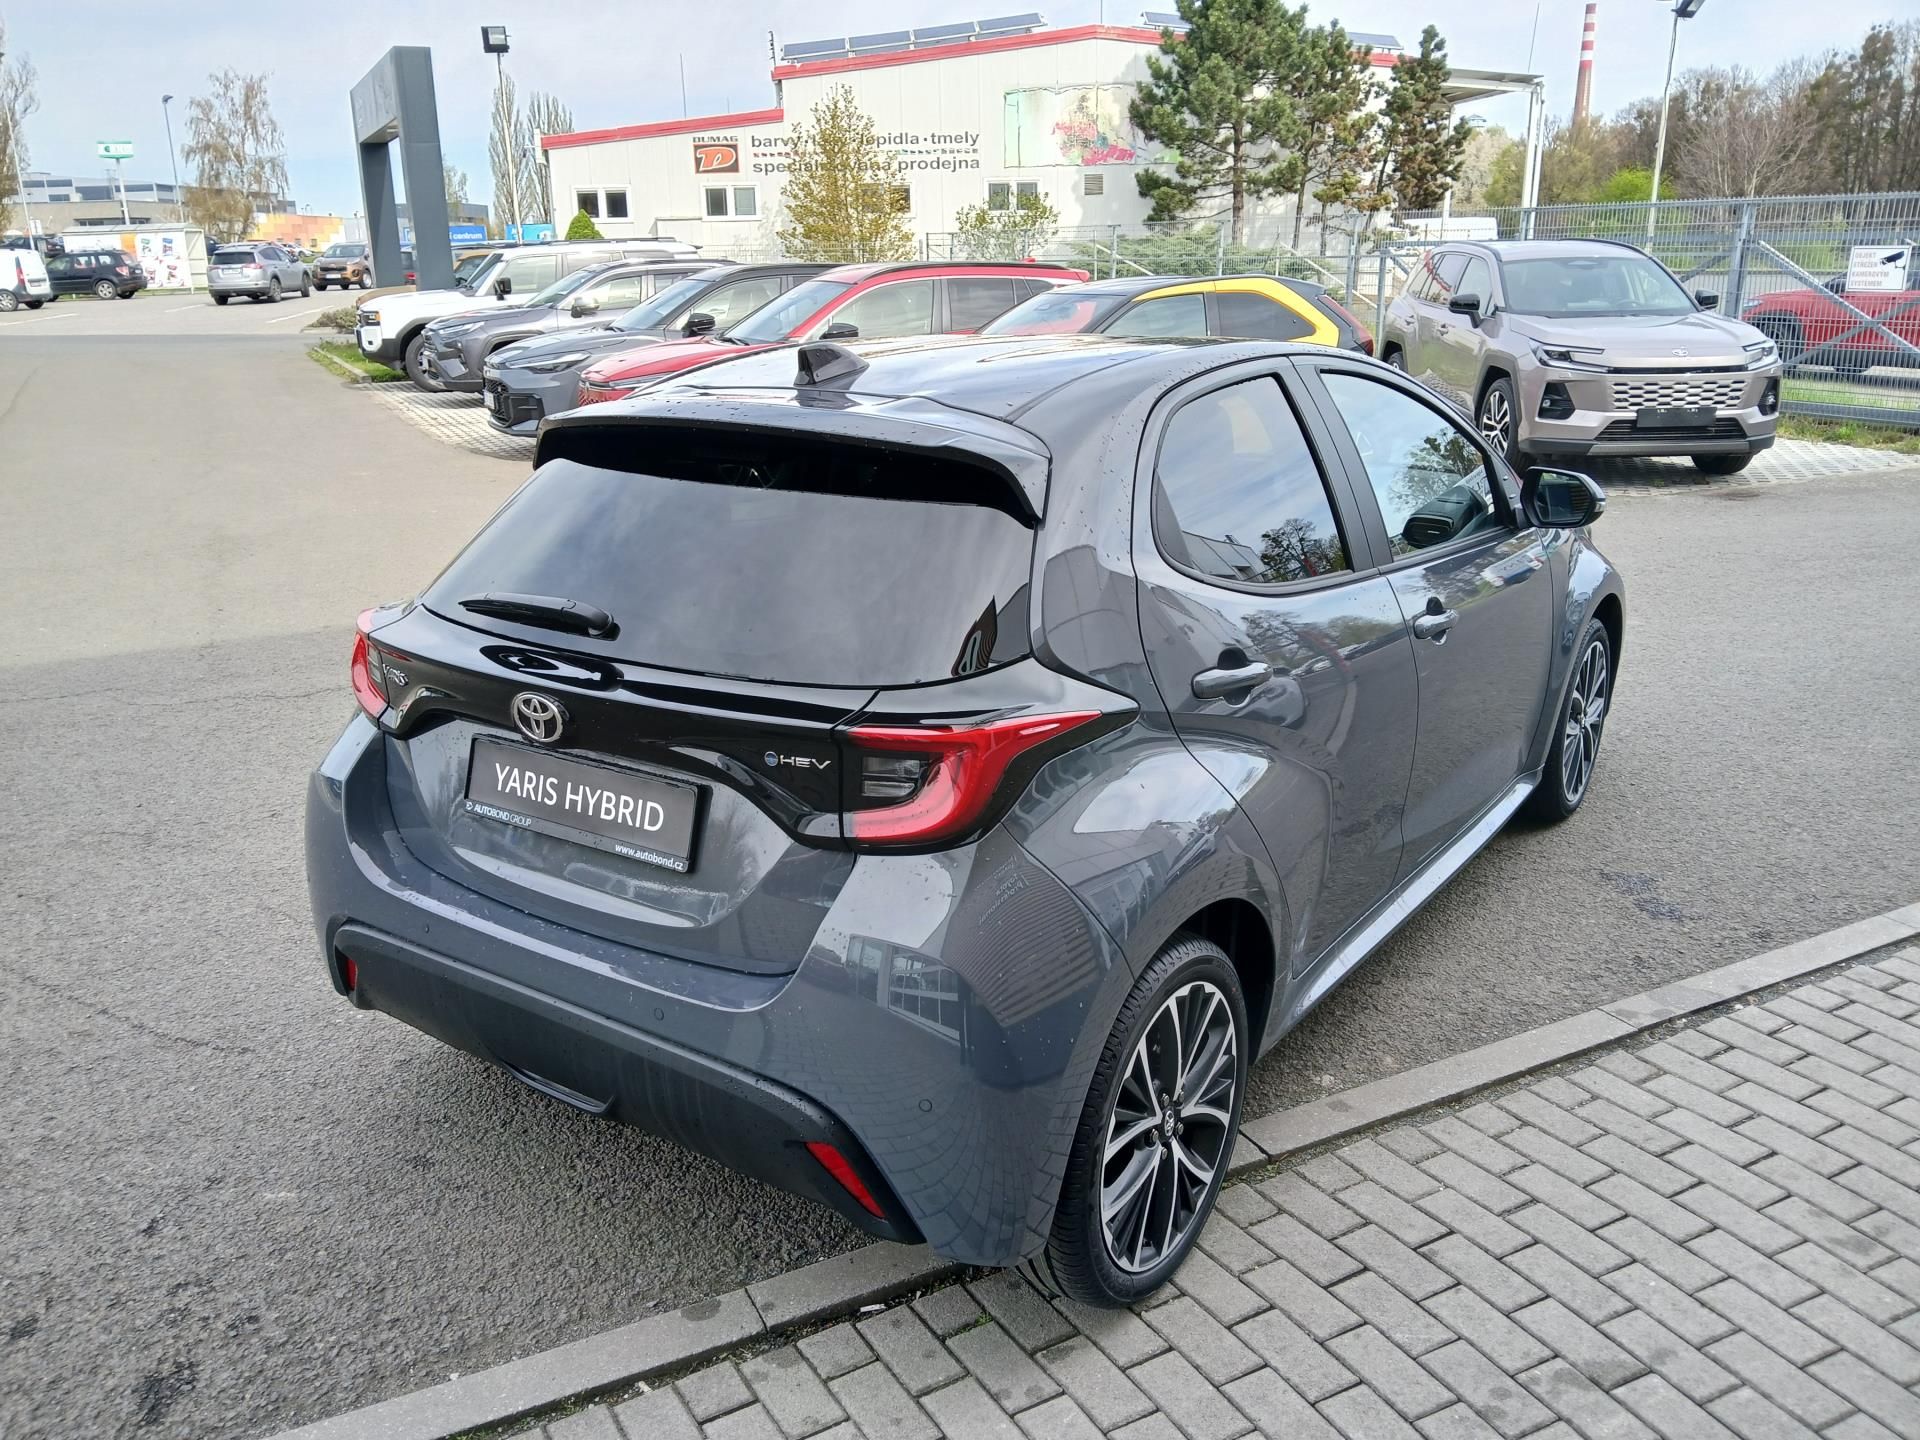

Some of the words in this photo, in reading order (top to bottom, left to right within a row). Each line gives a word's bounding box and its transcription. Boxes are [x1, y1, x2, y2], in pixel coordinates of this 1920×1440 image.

[751, 134, 800, 150] barvy
[931, 131, 980, 146] tmely
[898, 157, 980, 173] prodejna
[780, 754, 832, 769] HEV
[495, 762, 558, 806] YARIS
[564, 782, 664, 832] HYBRID
[473, 803, 510, 821] AUTOBOND
[510, 813, 532, 827] GROUP
[615, 843, 684, 871] www.autobond.cz
